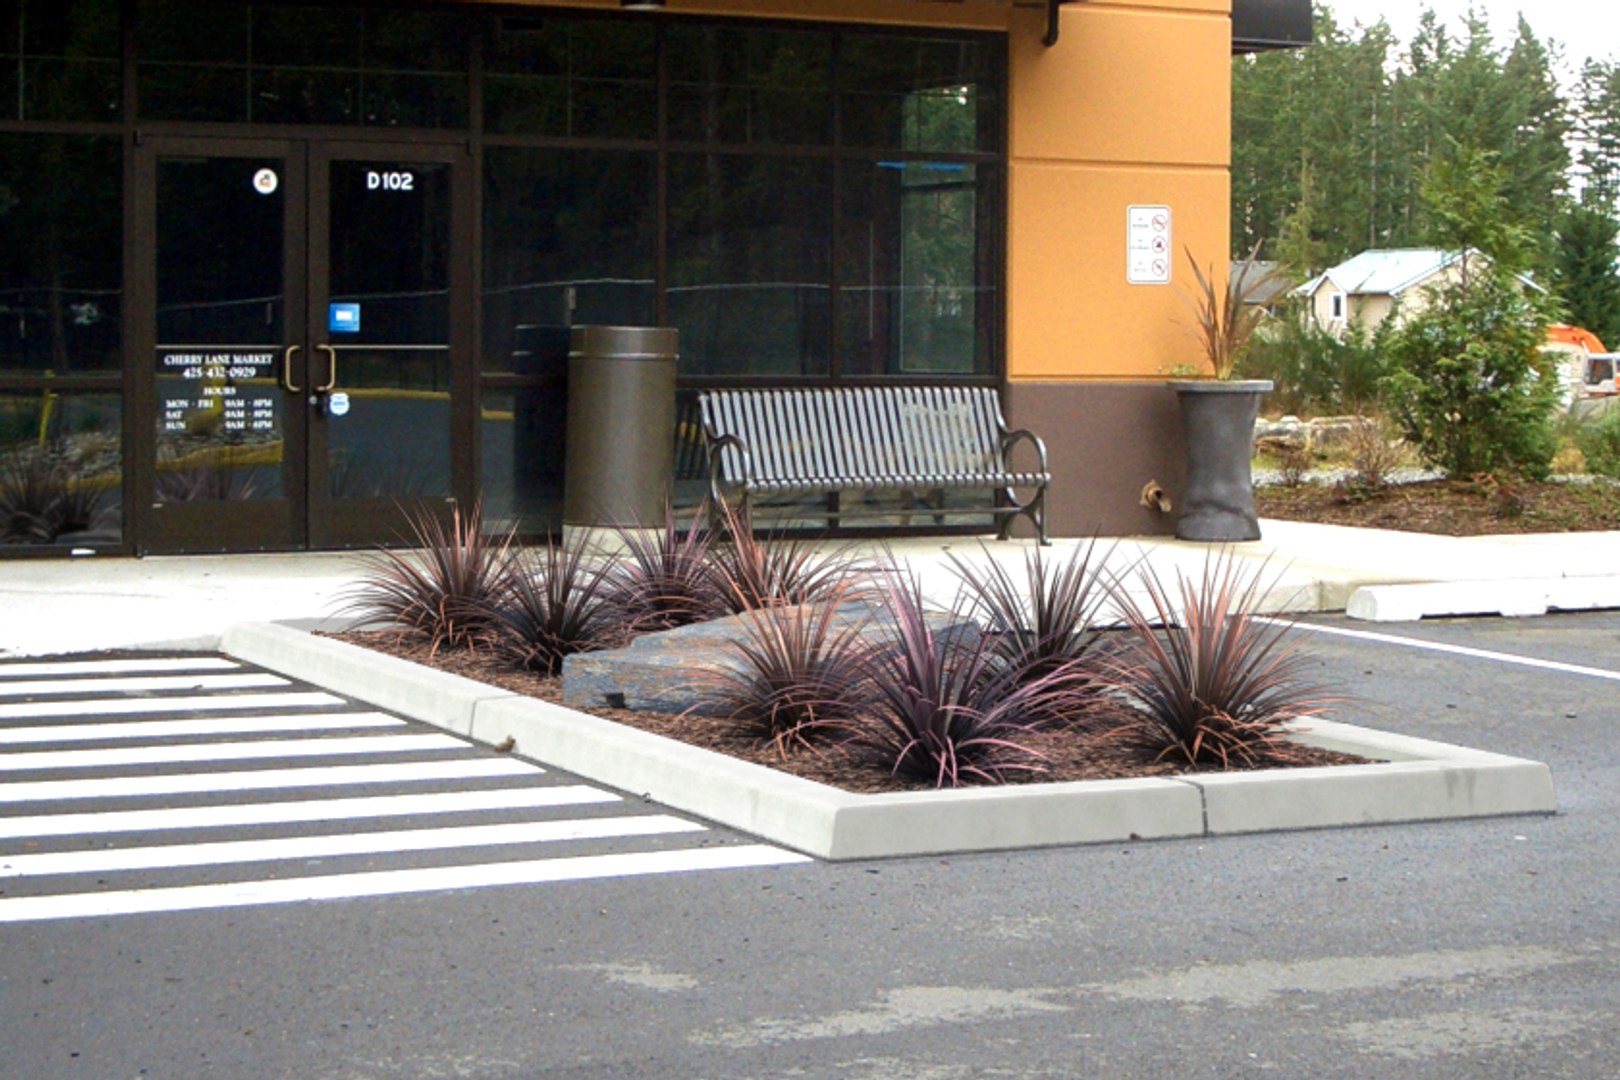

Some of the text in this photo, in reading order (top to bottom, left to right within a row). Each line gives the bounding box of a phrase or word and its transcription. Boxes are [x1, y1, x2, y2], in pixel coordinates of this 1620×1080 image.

[164, 354, 273, 365] CHERRY LANE MARKET
[203, 386, 237, 396] HOURS
[166, 399, 189, 408] MON
[197, 399, 214, 408] FRI
[166, 410, 183, 419] SAT
[166, 421, 186, 430] SUN
